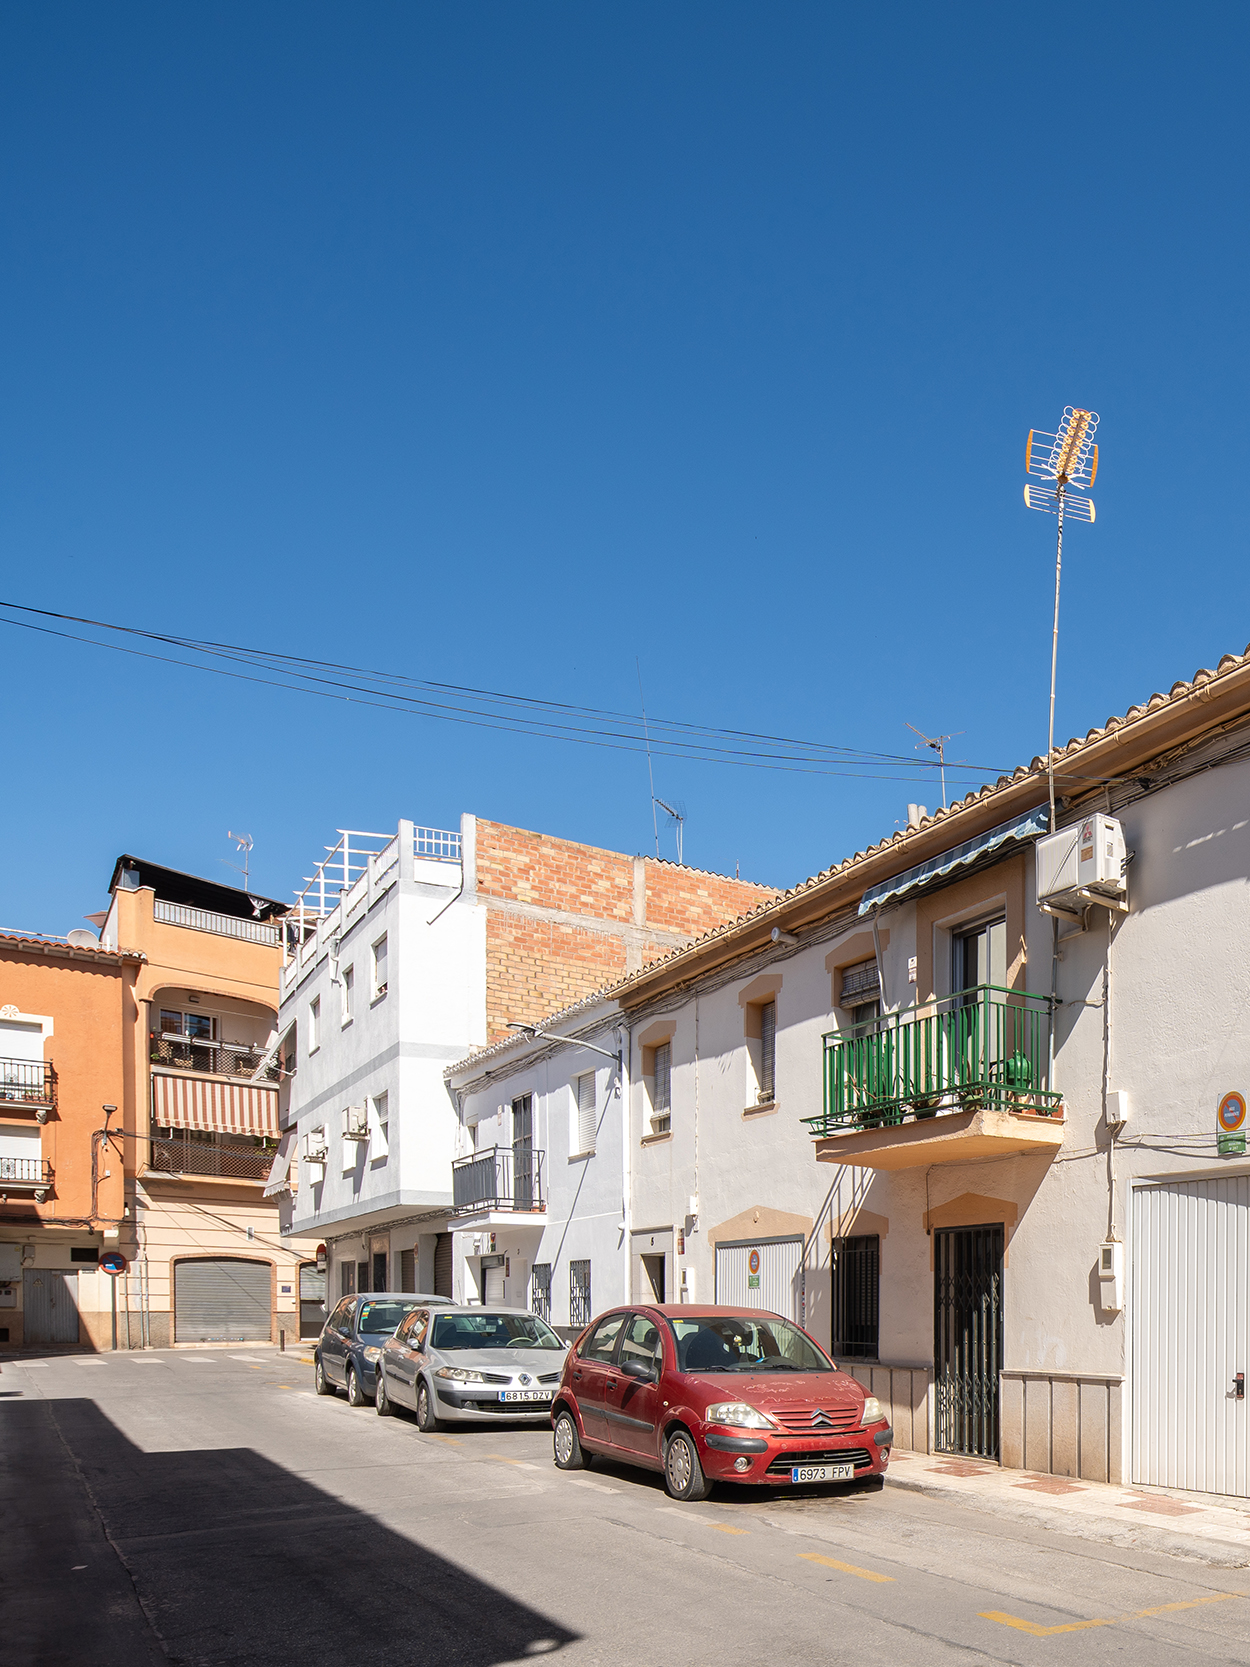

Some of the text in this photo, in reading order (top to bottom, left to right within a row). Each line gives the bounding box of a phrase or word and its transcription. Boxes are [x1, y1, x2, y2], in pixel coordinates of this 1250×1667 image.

[506, 1392, 530, 1400] 6815
[800, 1466, 851, 1480] 6973 FPV
